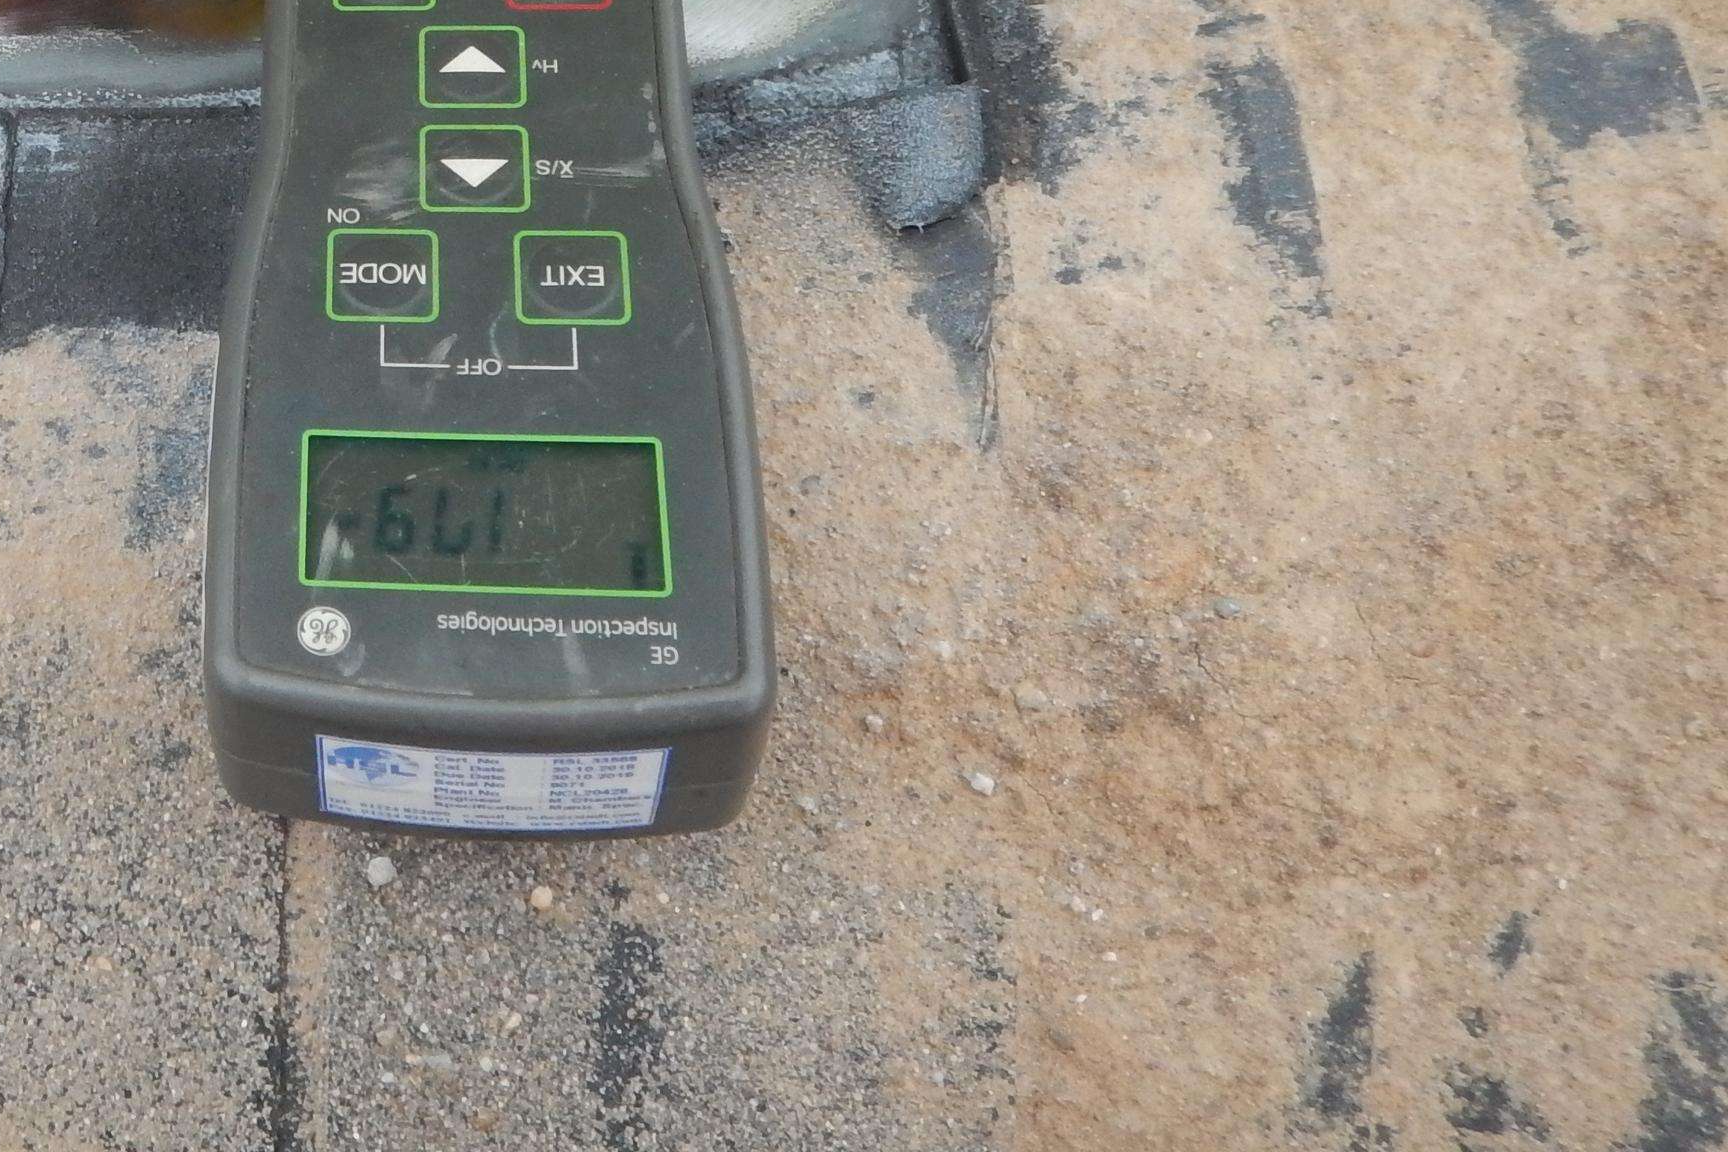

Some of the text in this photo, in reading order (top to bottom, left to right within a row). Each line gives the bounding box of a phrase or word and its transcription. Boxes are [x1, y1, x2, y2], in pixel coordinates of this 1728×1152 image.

[532, 59, 558, 74] Hv
[328, 207, 361, 224] ON
[340, 263, 426, 284] MODE
[540, 265, 605, 287] EXIT
[456, 358, 502, 376] OFF
[437, 611, 678, 640] Inspection Technologies
[650, 646, 680, 665] GE
